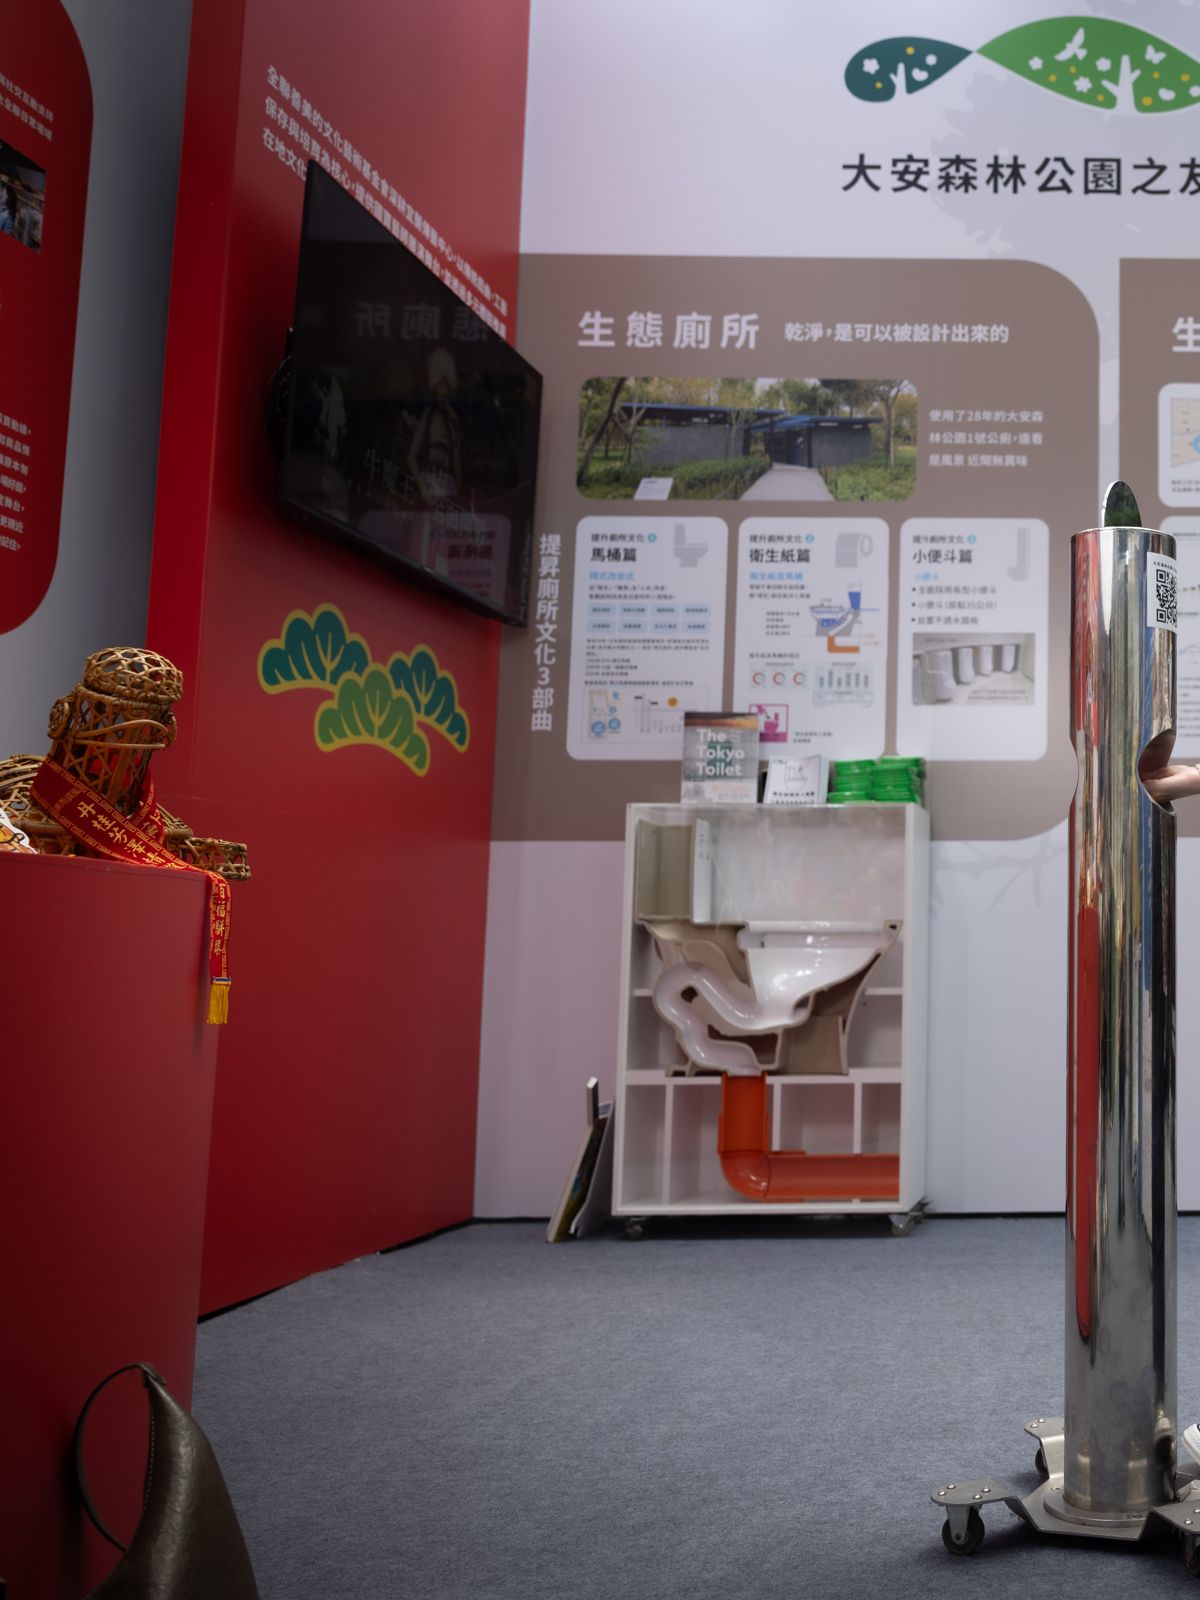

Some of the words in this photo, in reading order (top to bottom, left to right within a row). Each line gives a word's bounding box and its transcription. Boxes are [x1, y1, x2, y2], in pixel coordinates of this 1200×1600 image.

[577, 311, 760, 350] 生態廁所
[785, 322, 1009, 344] 乾淨，是可以被設計出來的
[590, 547, 637, 562] 馬桶篇
[749, 548, 810, 563] 衛生紙篇
[912, 549, 973, 564] 小便斗篇
[531, 534, 562, 731] 提昇廁所文化3部曲
[696, 728, 728, 743] The
[696, 746, 745, 762] Tokyo
[695, 762, 743, 777] Toilet
